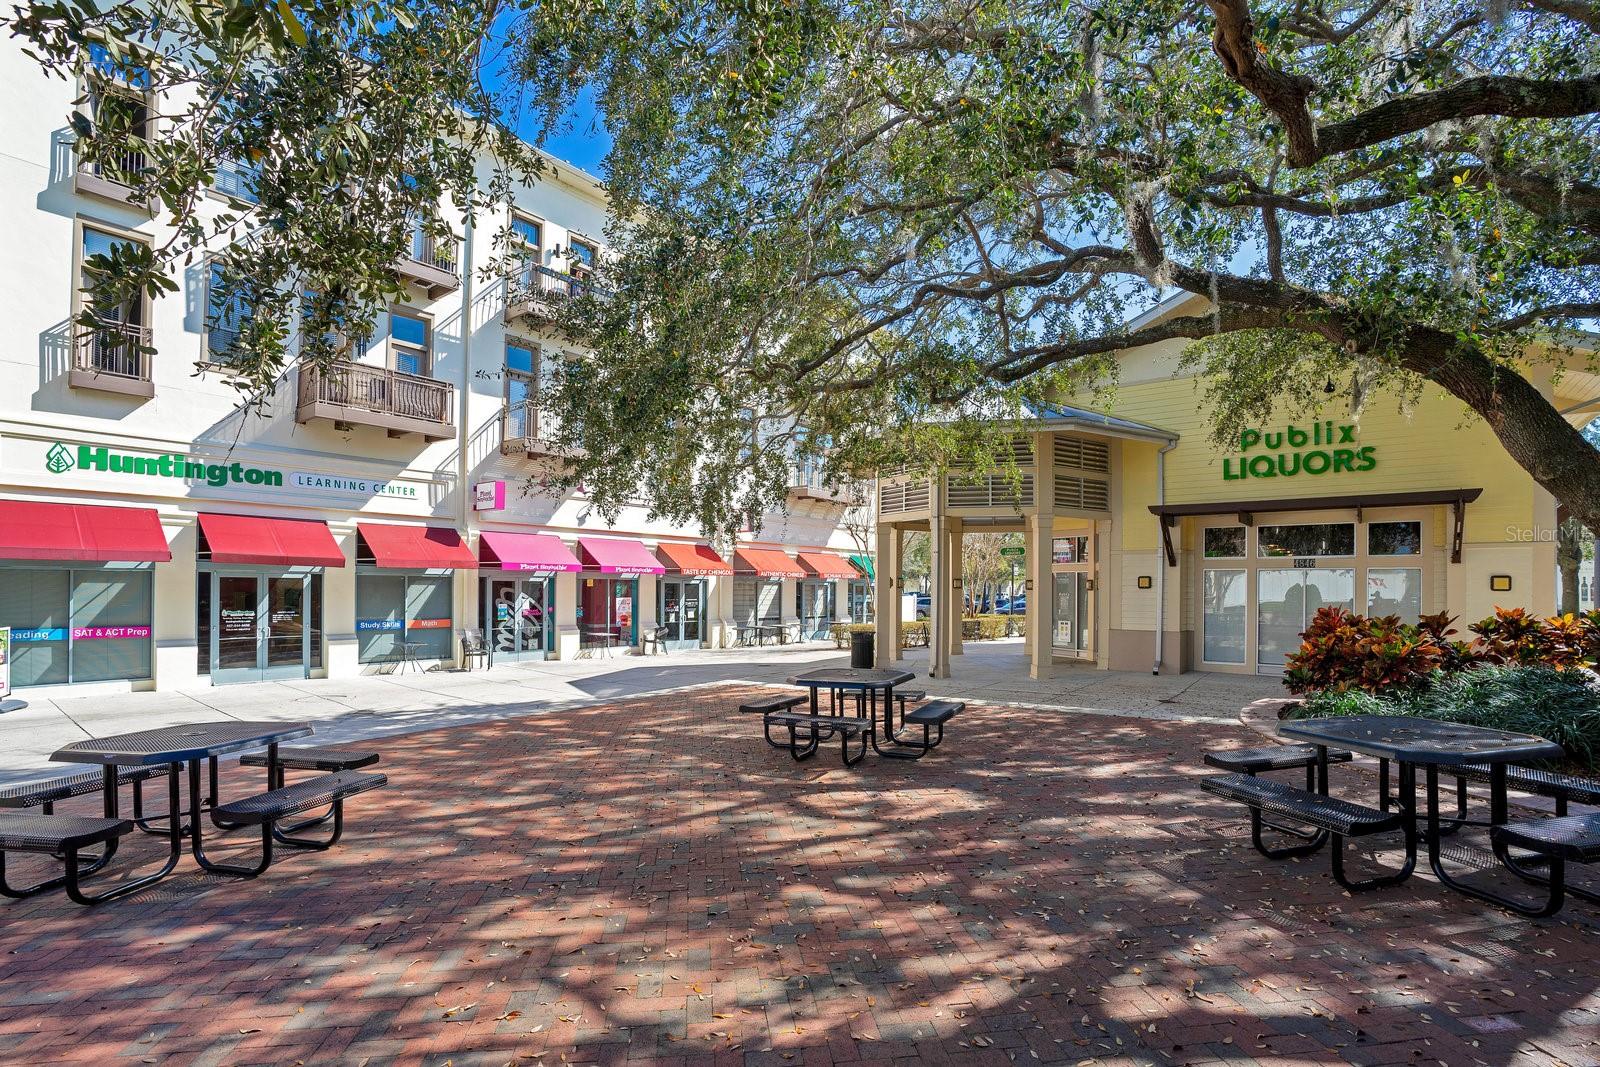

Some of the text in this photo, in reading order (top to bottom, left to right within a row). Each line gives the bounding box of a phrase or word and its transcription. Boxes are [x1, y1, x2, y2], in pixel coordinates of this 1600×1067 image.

[1240, 421, 1355, 452] Publix
[77, 445, 283, 487] Huntington
[1223, 446, 1377, 480] LIQUORS
[298, 476, 415, 496] LEARNING CENTER
[9, 631, 49, 640] eading
[74, 628, 148, 638] SAT & ACT Prep
[360, 621, 401, 630] Study Skills
